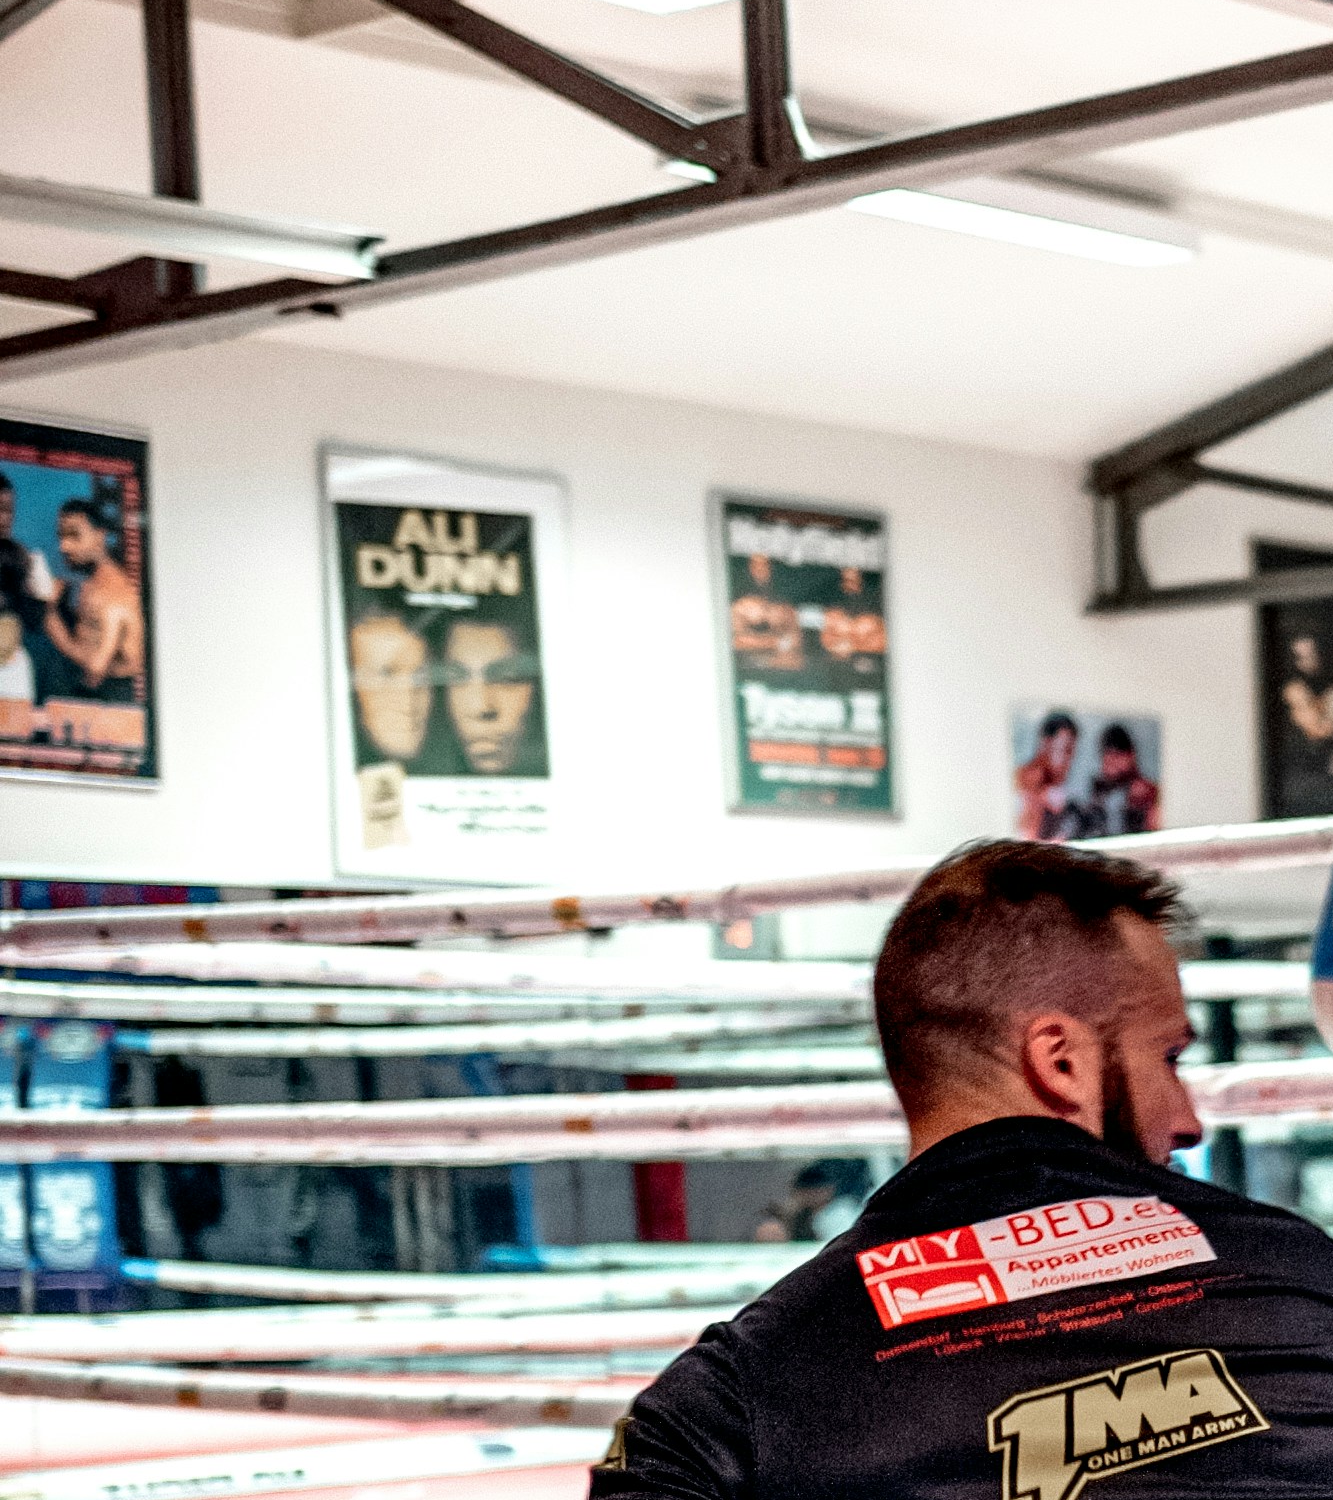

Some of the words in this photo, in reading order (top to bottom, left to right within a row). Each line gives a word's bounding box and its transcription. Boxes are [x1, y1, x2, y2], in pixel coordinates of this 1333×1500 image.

[394, 508, 478, 555] ALI
[354, 543, 523, 597] DUNN
[858, 1231, 963, 1275] MY
[1006, 1223, 1201, 1276] Appartements
[1126, 1248, 1195, 1273] Wohnen
[1087, 1446, 1133, 1471] ONE
[1138, 1429, 1187, 1456] MAN
[1190, 1413, 1249, 1441] ARMY
